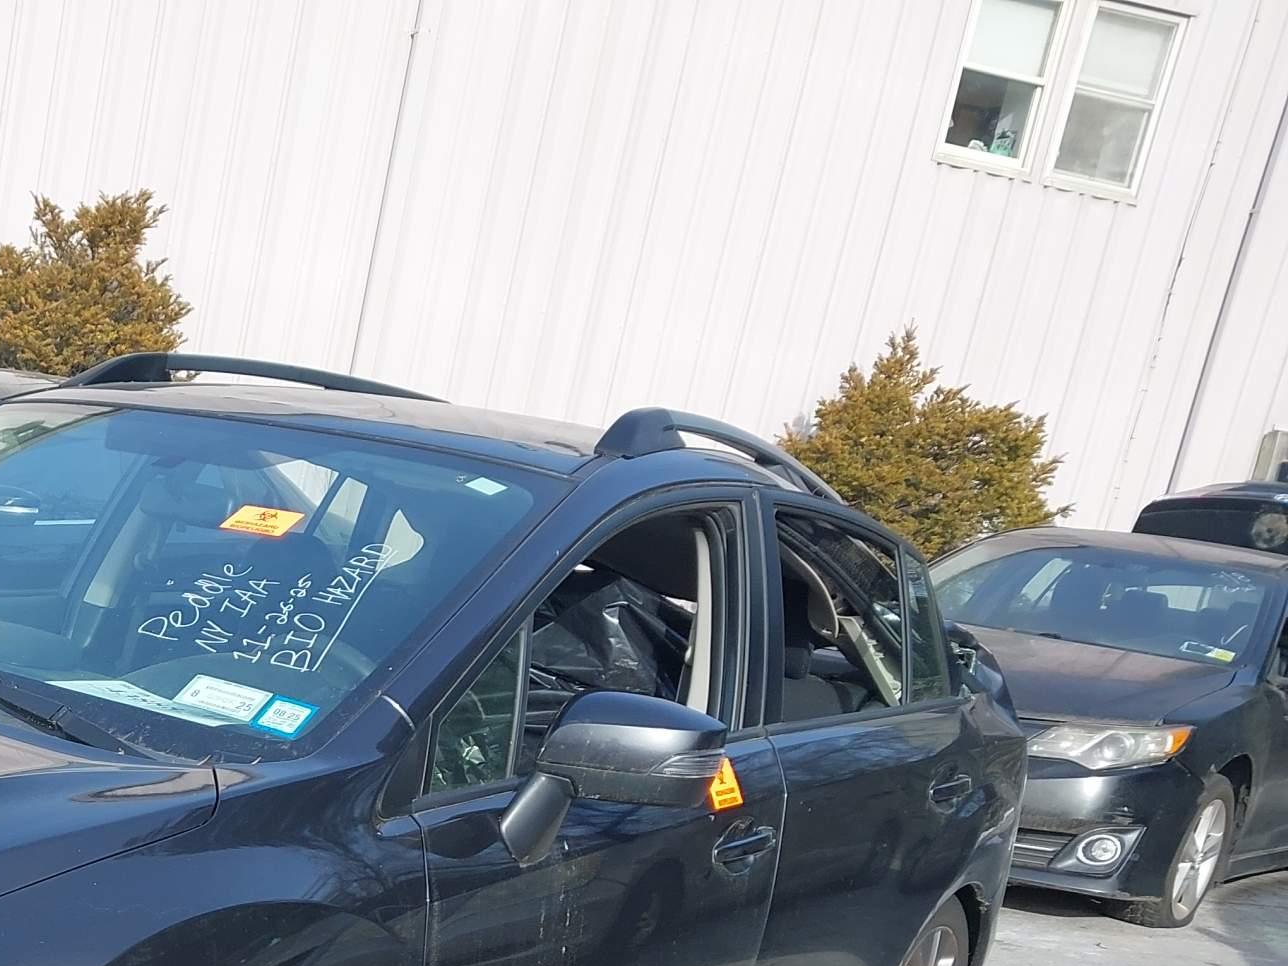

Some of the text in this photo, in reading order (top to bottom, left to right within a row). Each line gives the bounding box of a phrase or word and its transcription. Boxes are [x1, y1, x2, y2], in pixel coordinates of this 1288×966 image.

[194, 620, 234, 653] NY
[220, 578, 281, 618] IAA
[270, 612, 327, 673] BIO
[312, 543, 394, 605] HAZARD
[235, 701, 254, 713] 25
